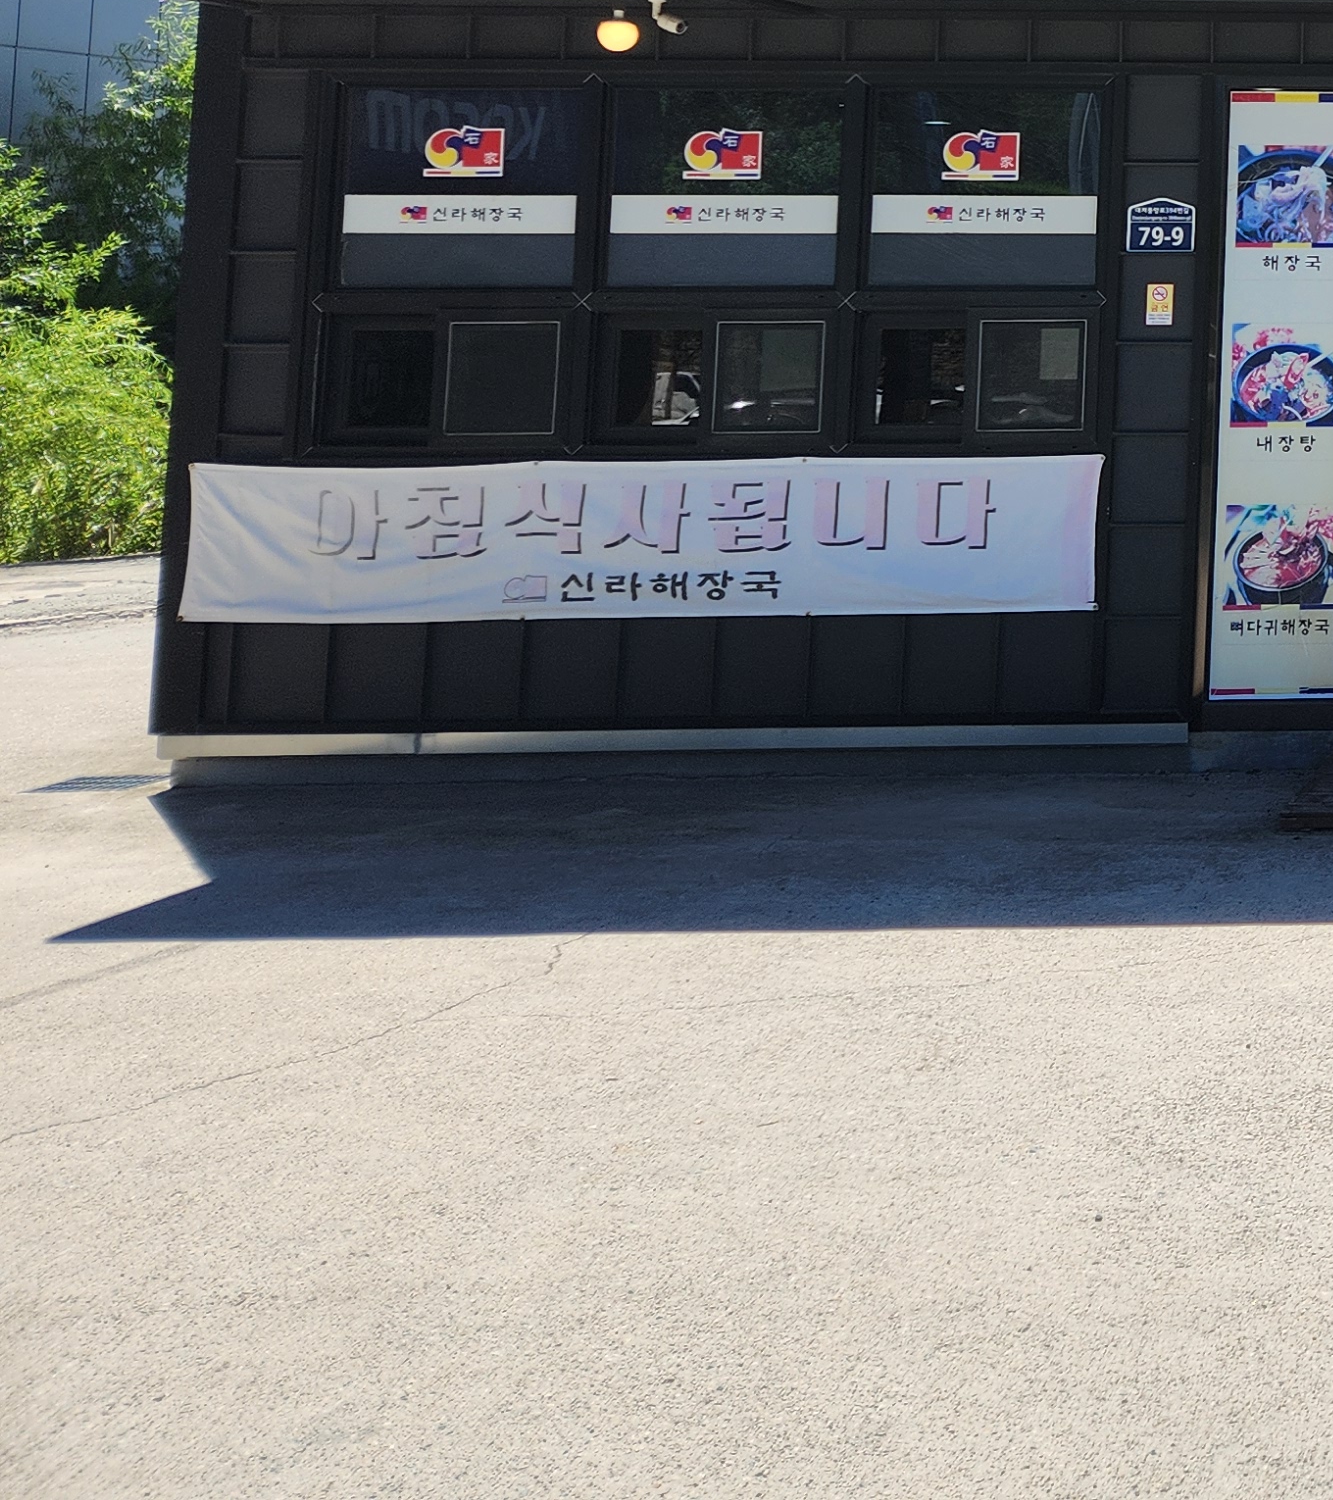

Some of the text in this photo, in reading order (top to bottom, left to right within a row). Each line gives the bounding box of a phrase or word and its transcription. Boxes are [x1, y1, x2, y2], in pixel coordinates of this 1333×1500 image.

[433, 207, 524, 222] 신라해장국
[698, 207, 786, 222] 신라해장국
[959, 207, 1046, 222] 신라해장국
[1138, 226, 1184, 246] 79-9
[1261, 254, 1322, 272] 해장국
[1256, 434, 1317, 453] 내장탕
[312, 476, 998, 561] 아침식사됩니다
[560, 570, 783, 603] 신라해장국
[1229, 618, 1331, 637] 뼈다귀해장국
